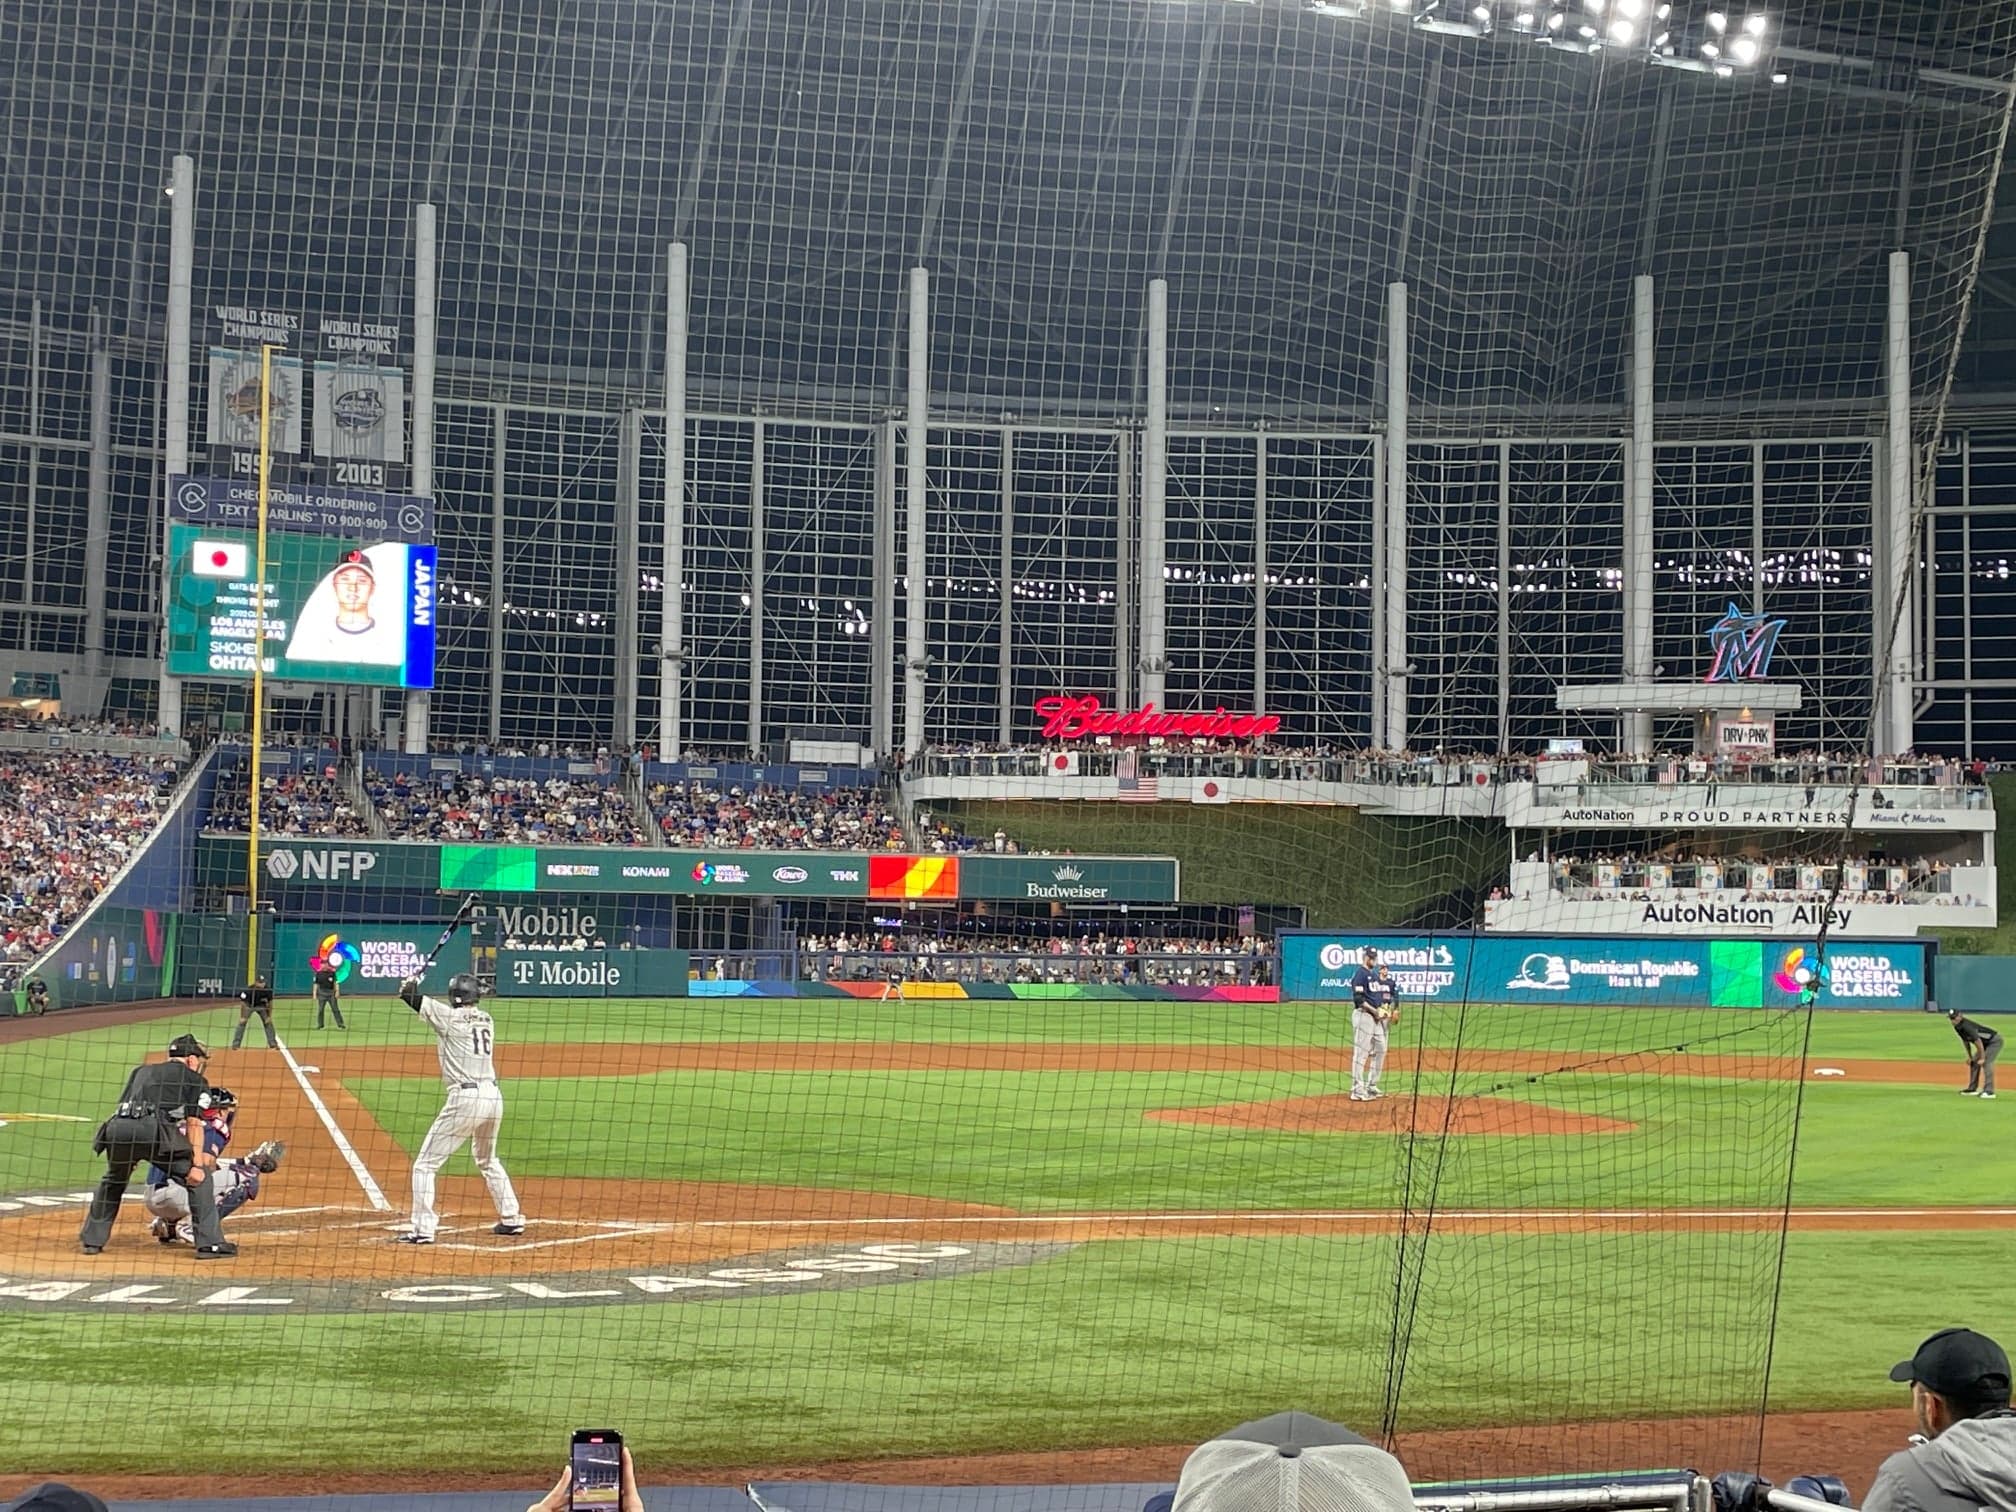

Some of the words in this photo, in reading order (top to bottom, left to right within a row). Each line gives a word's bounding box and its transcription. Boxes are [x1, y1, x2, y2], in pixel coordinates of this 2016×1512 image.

[216, 305, 257, 323] WORLD
[260, 311, 298, 329] SERIES
[224, 322, 289, 343] CHAMPIONS
[320, 319, 361, 336] WORLD
[363, 324, 399, 339] SERIES
[328, 336, 392, 354] CHAMPIONS
[336, 463, 383, 485] 2003
[267, 490, 313, 507] MOBILE
[316, 496, 377, 513] ORDERING
[218, 503, 249, 517] TEXT
[321, 513, 337, 525] TO
[414, 559, 431, 625] JAPAN
[1035, 696, 1280, 738] Budweiser
[1723, 727, 1745, 743] DRV
[1749, 727, 1768, 743] PNK
[1563, 809, 1634, 821] AutoNation
[1660, 811, 1729, 822] PROUD
[1743, 811, 1852, 823] PARTNERS
[1870, 813, 1899, 823] Miami
[303, 850, 376, 881] NFP
[622, 866, 670, 877] KONAMI
[1026, 882, 1108, 898] Budweiser
[495, 906, 597, 937] Mobile
[1642, 903, 1773, 924] AutoNation
[1791, 905, 1852, 930] Alley
[361, 941, 416, 954] WORLD
[1570, 959, 1639, 975] Dominican
[1641, 961, 1699, 977] Republic
[1830, 956, 1889, 970] WORLD
[539, 962, 620, 985] Mobile
[1608, 976, 1631, 987] Has
[1830, 969, 1912, 984] BASEBALL
[198, 979, 222, 994] 344
[472, 1028, 491, 1055] 16
